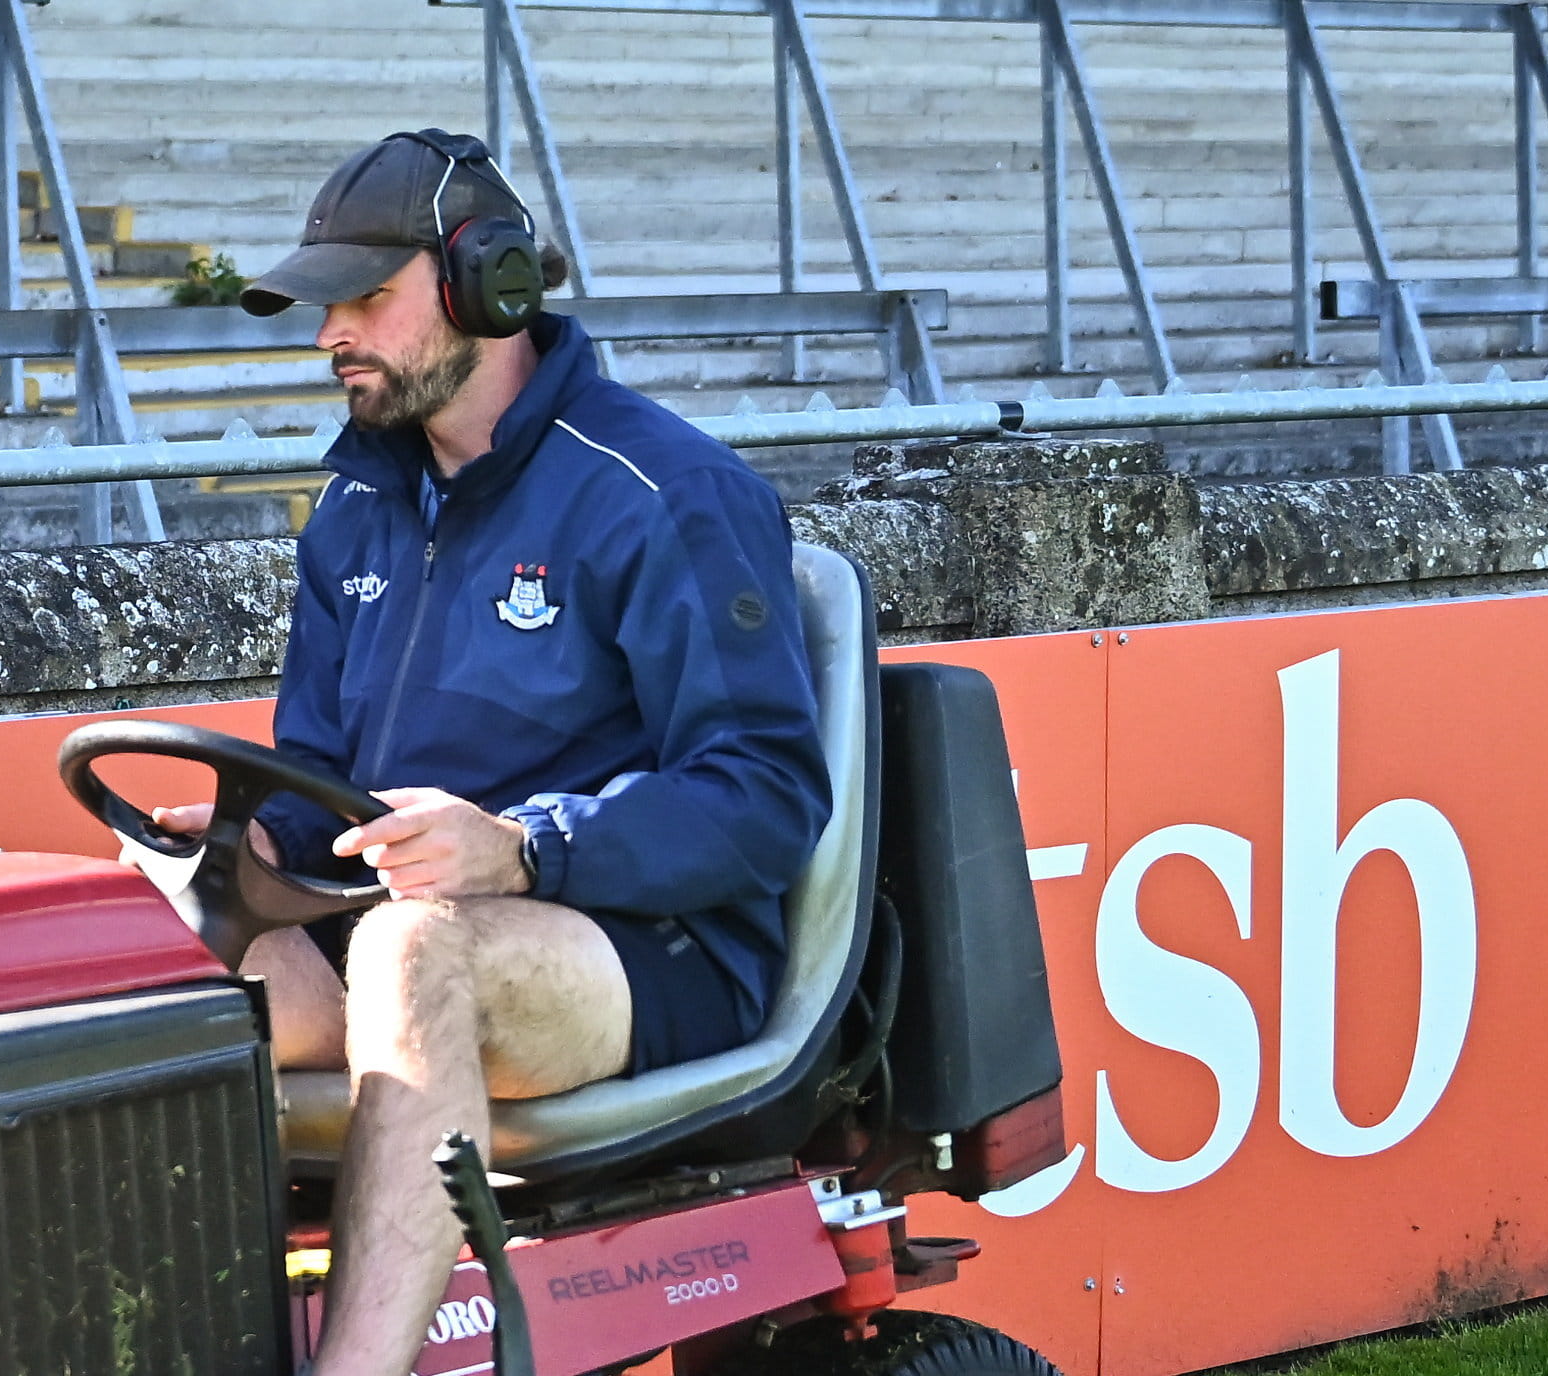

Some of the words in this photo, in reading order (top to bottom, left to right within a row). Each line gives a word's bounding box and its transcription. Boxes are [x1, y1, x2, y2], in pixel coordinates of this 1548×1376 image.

[979, 648, 1478, 1218] sb
[547, 1240, 750, 1302] REELMASTER
[427, 1295, 497, 1345] ORO
